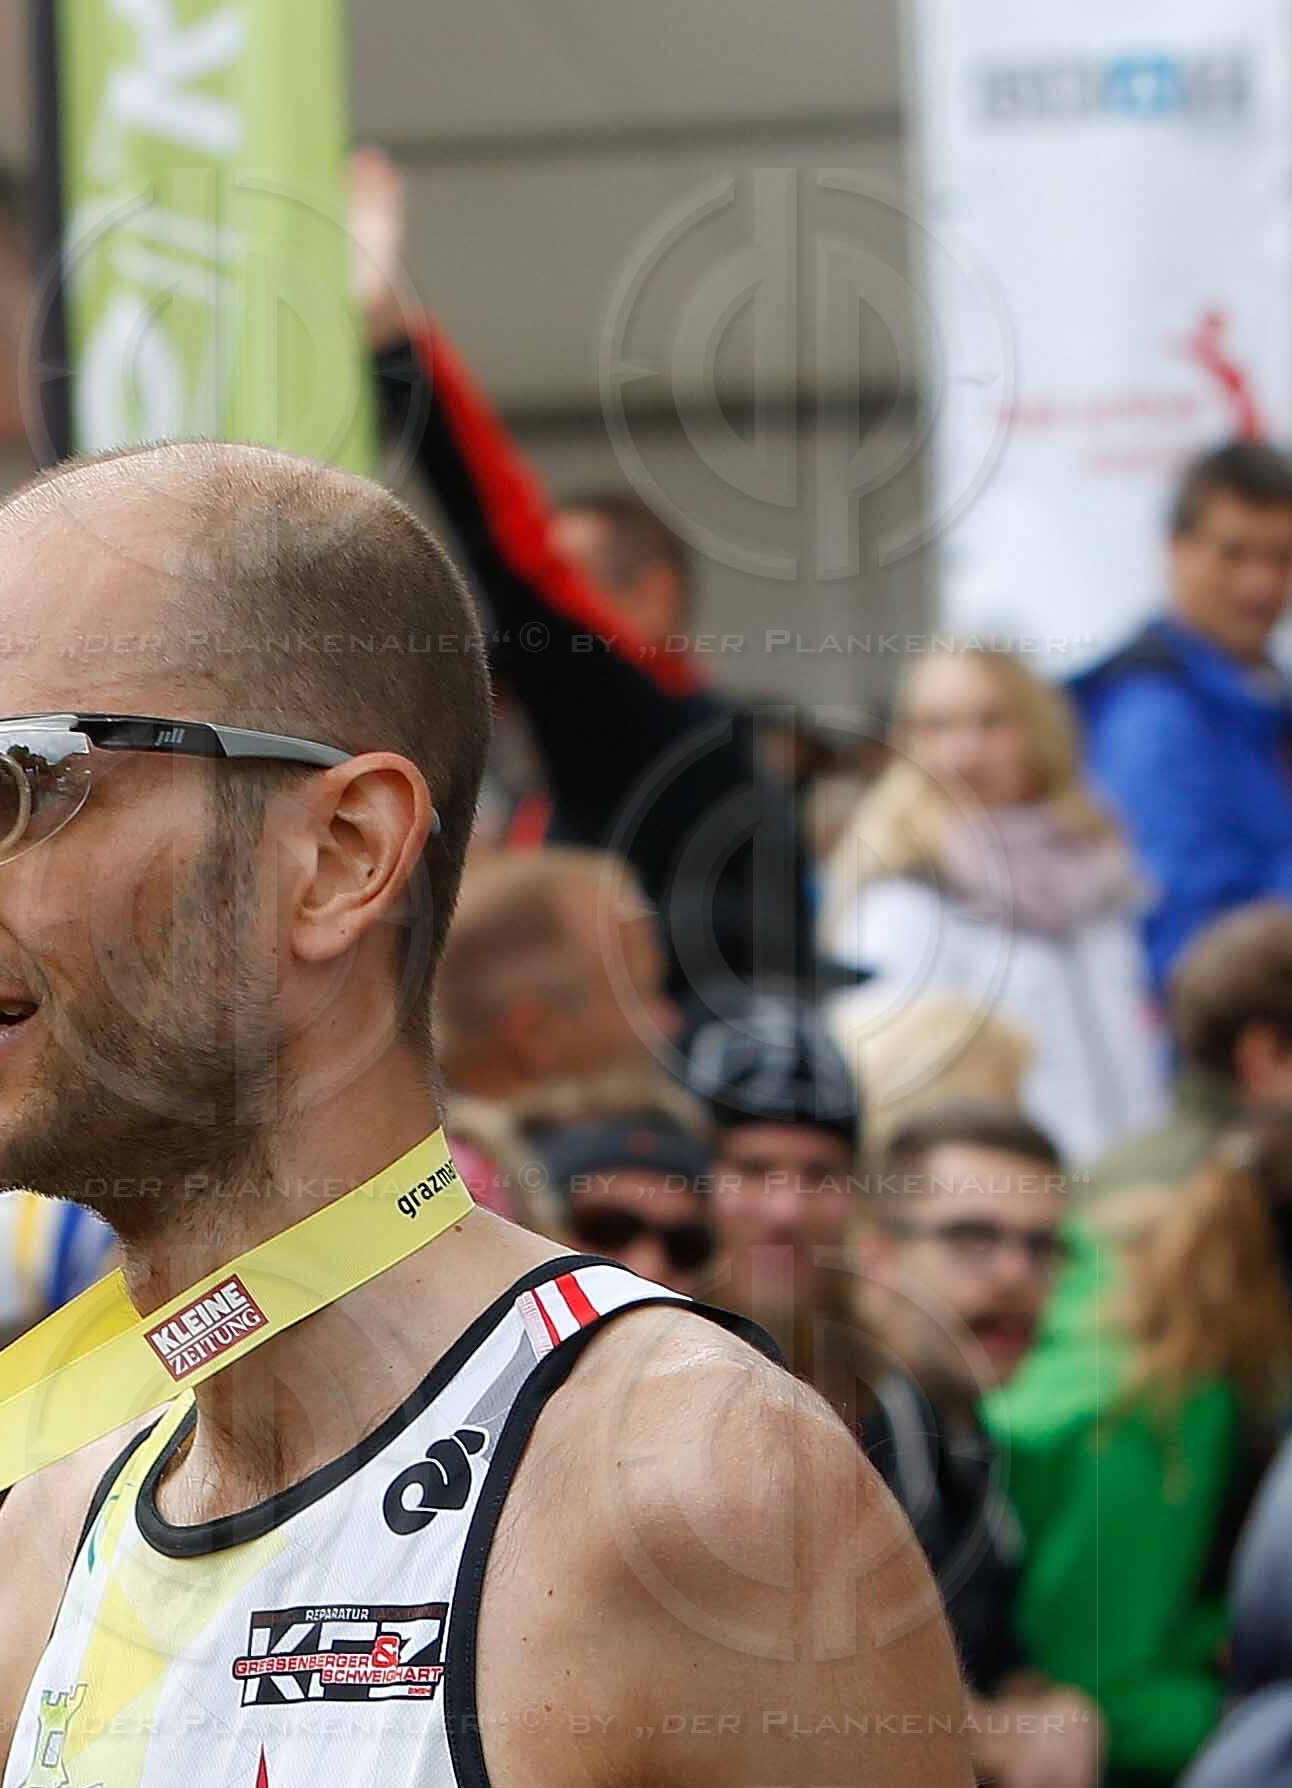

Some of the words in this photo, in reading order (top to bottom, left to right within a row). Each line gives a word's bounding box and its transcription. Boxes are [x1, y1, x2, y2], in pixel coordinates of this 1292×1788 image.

[151, 1281, 247, 1356] KLEINE
[167, 1308, 262, 1376] ZEITUNG
[305, 1607, 370, 1622] REPARATUR
[372, 1635, 398, 1668] &
